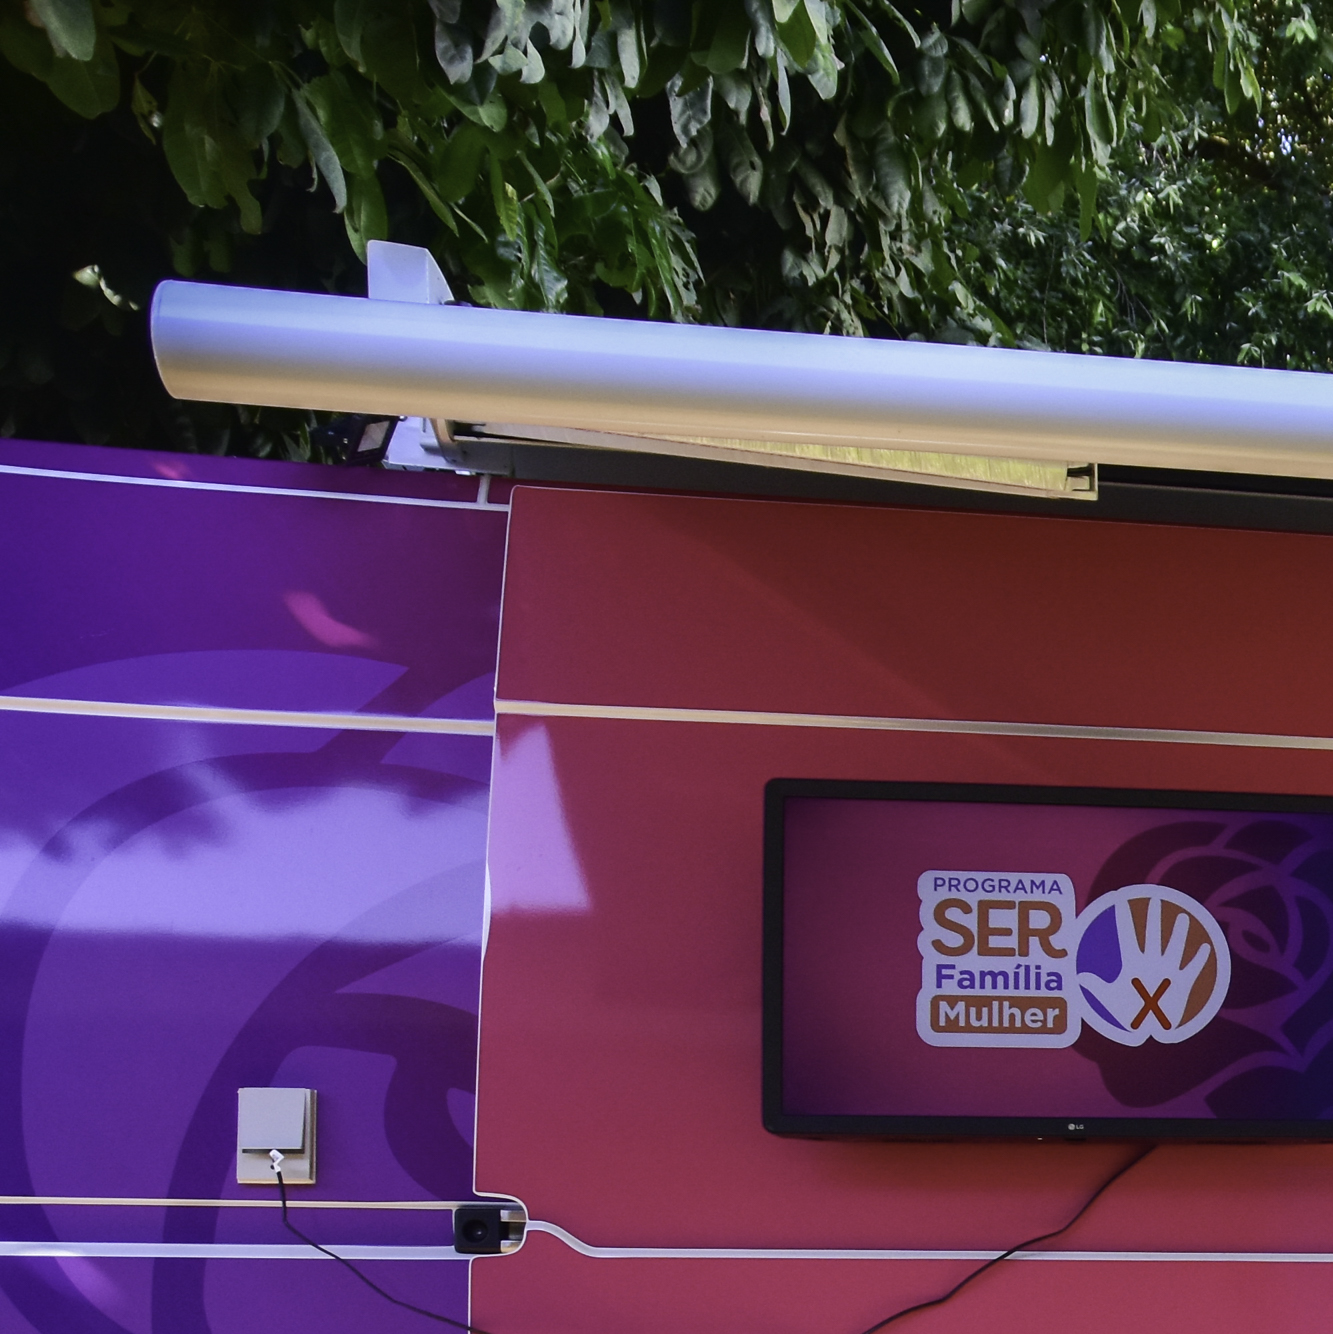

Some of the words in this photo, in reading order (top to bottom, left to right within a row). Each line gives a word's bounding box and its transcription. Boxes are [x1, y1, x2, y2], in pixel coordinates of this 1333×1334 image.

[933, 877, 1063, 895] PROGRAMA
[931, 898, 1068, 959] SER
[935, 963, 1063, 991] Família
[938, 1001, 1060, 1028] Mulher
